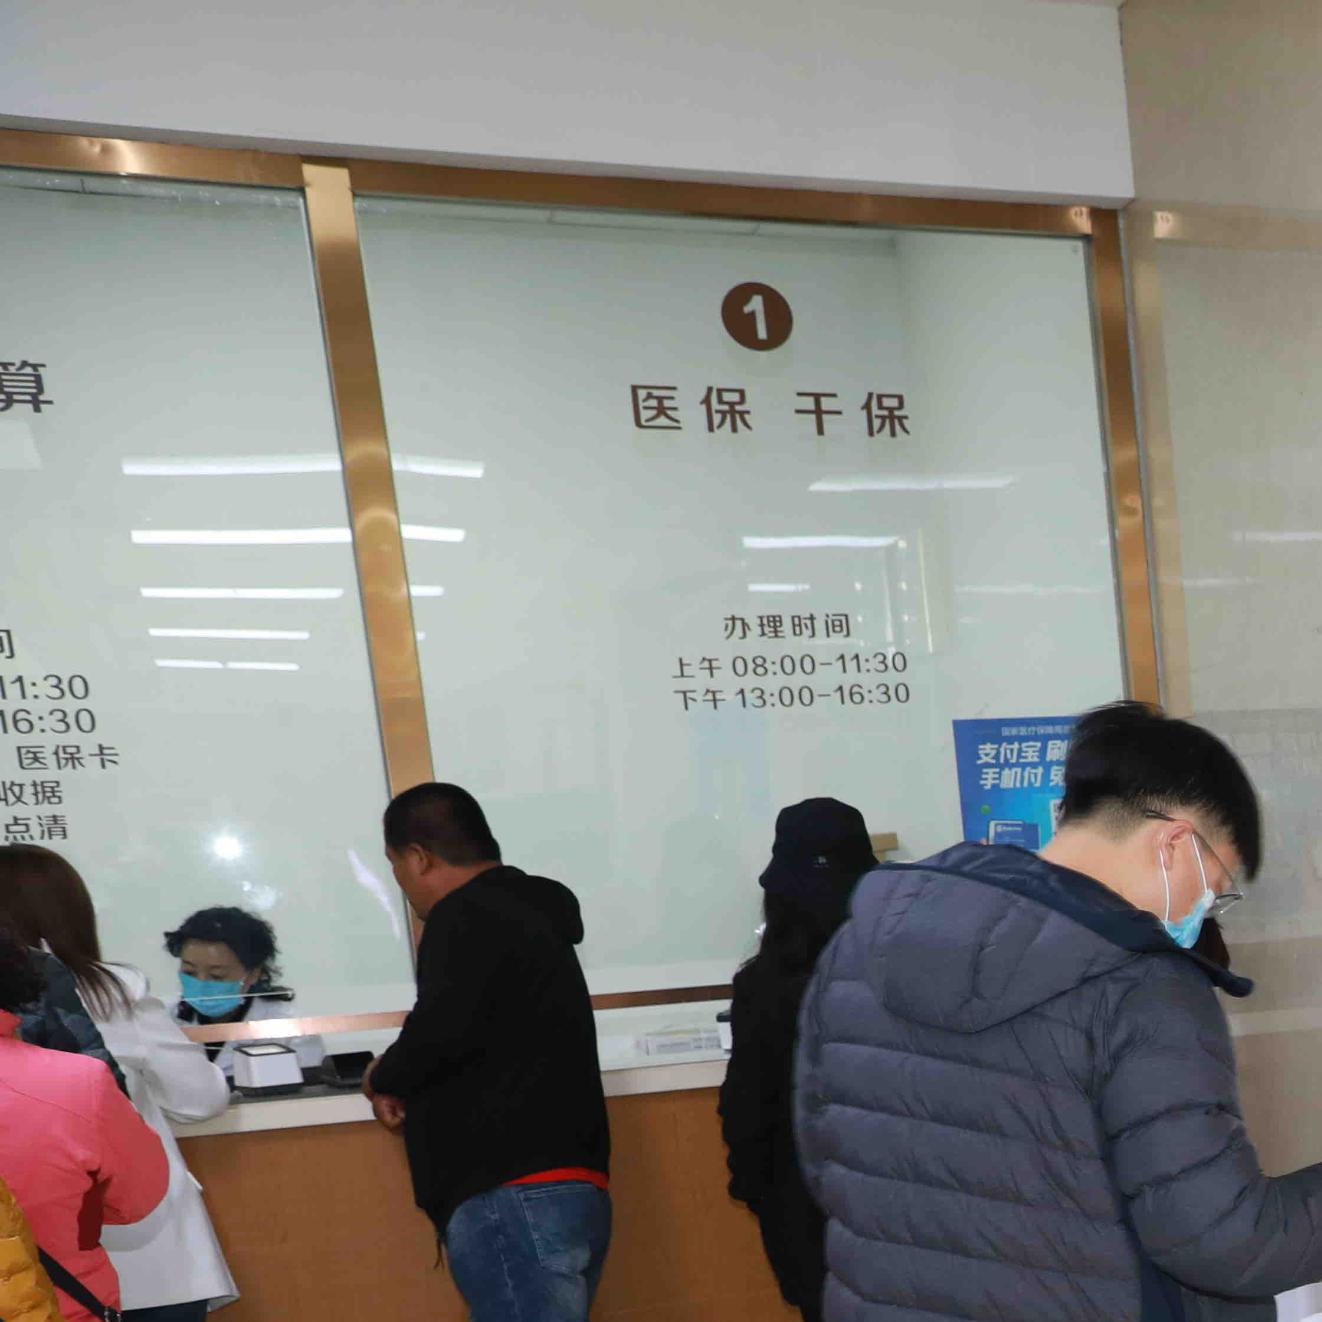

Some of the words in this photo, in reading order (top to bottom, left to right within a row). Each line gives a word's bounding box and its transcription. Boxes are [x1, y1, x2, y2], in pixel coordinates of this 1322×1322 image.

[743, 294, 768, 341] 1
[0, 360, 54, 414] 算
[723, 613, 851, 640] 办理时间
[672, 657, 722, 679] 上午
[732, 651, 908, 678] 08:00-11:30
[673, 688, 726, 711] 下午
[734, 683, 910, 709] 13:00-16:30
[16, 743, 119, 770] 医保卡
[976, 741, 1042, 764] 支付宝
[980, 766, 1044, 790] 手机付
[0, 780, 63, 807] 收据
[4, 814, 67, 842] 点清
